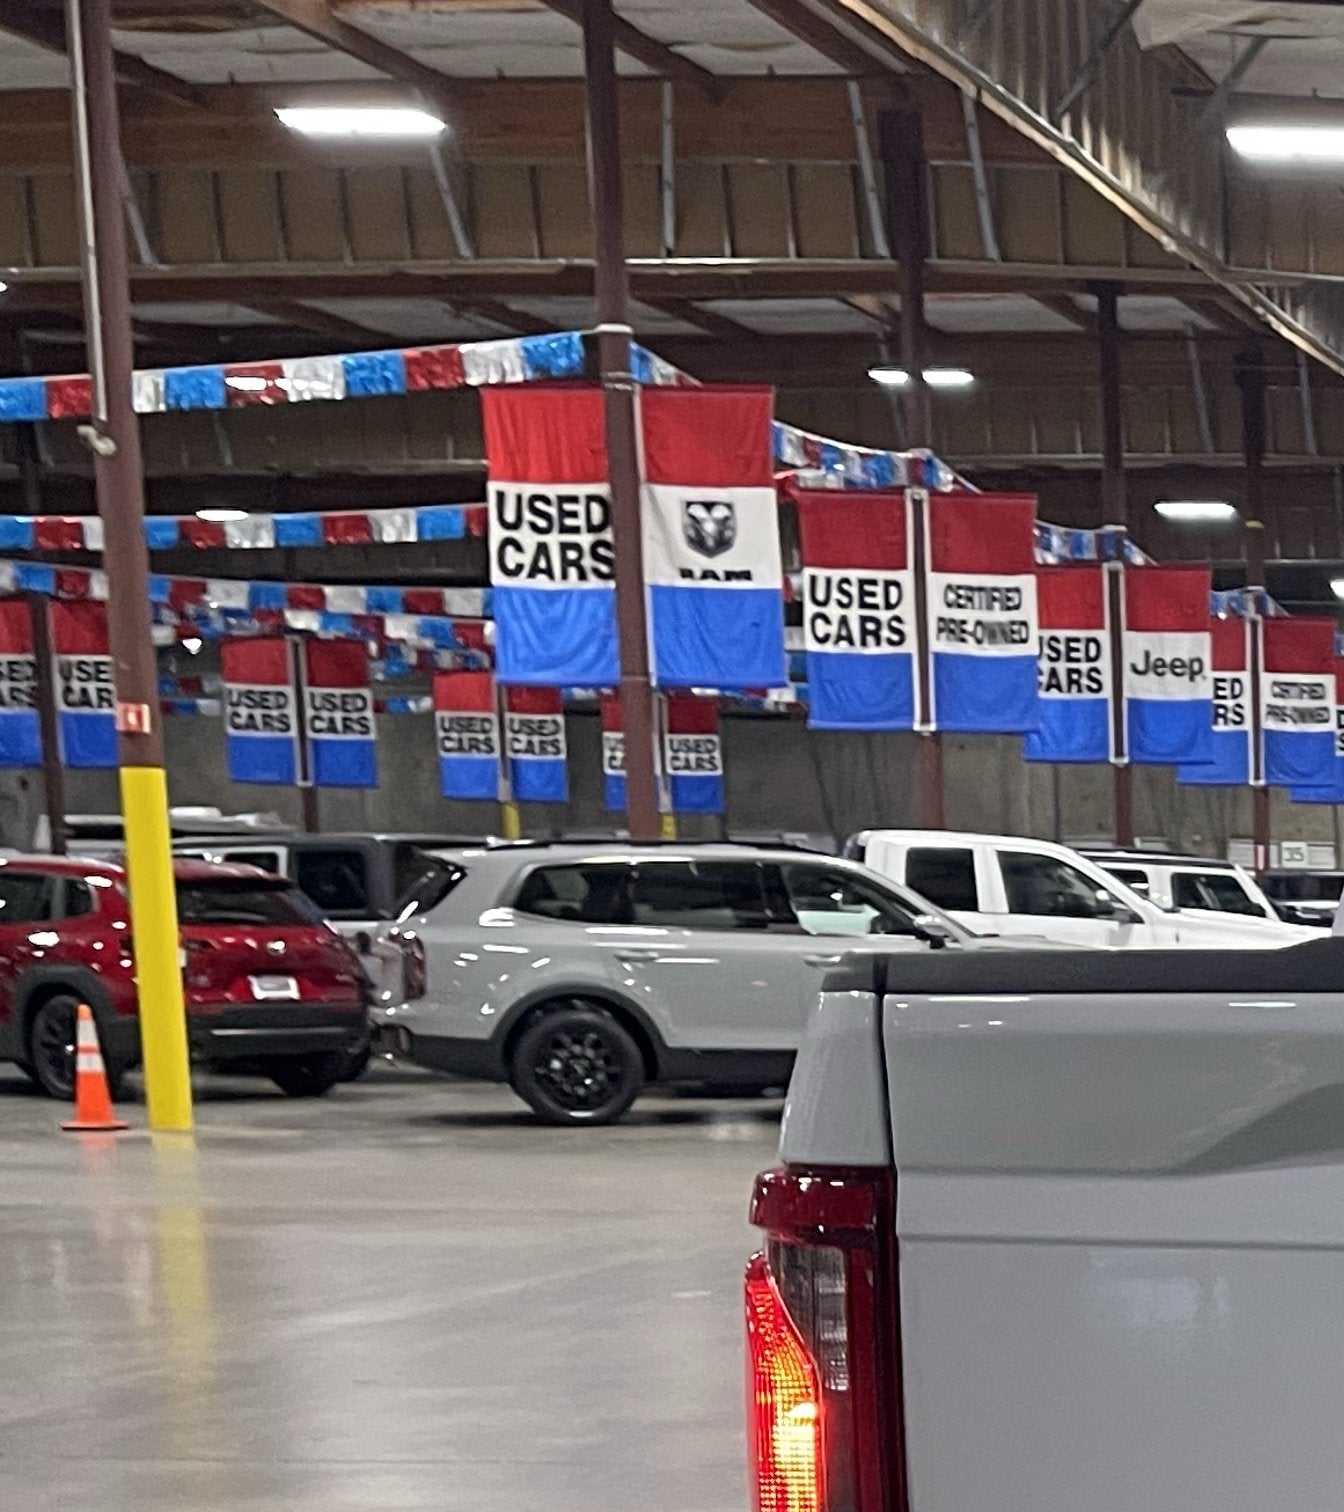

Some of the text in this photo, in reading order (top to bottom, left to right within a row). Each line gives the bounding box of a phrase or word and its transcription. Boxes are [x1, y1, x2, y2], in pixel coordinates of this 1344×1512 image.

[495, 490, 610, 534] USED
[499, 536, 615, 581] CARS
[809, 574, 903, 611] USED
[810, 612, 907, 648] CARS
[1038, 666, 1104, 694] ARS
[1130, 650, 1204, 682] Jeep
[228, 689, 289, 710] USED
[308, 692, 368, 713] USED
[229, 711, 291, 733] CARS
[310, 714, 370, 735] CARS
